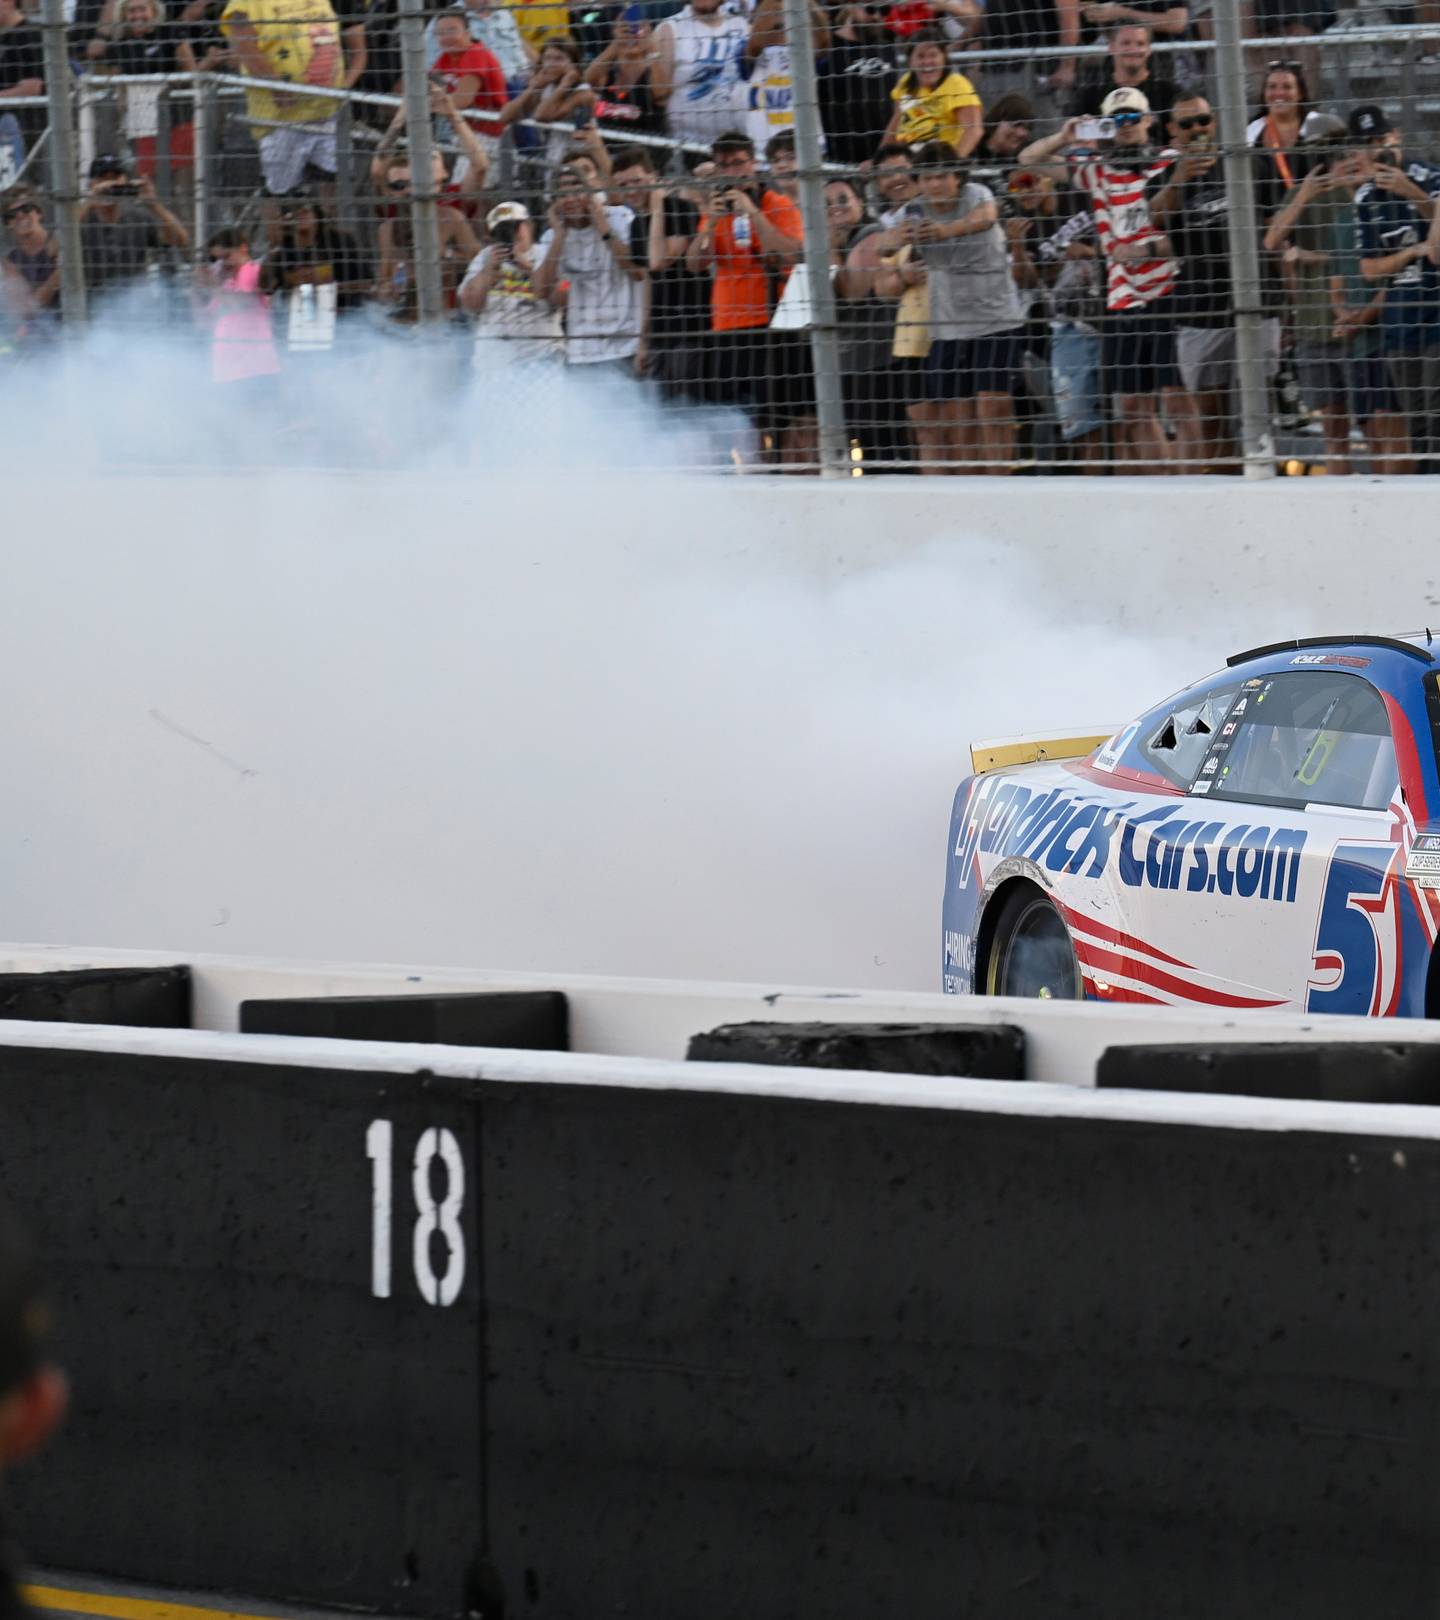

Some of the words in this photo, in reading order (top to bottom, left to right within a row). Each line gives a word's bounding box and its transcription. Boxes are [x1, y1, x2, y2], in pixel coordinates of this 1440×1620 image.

[1412, 855, 1425, 867] CUP
[945, 930, 971, 971] HIRING
[1305, 841, 1402, 1017] 5
[366, 1119, 466, 1307] 18
